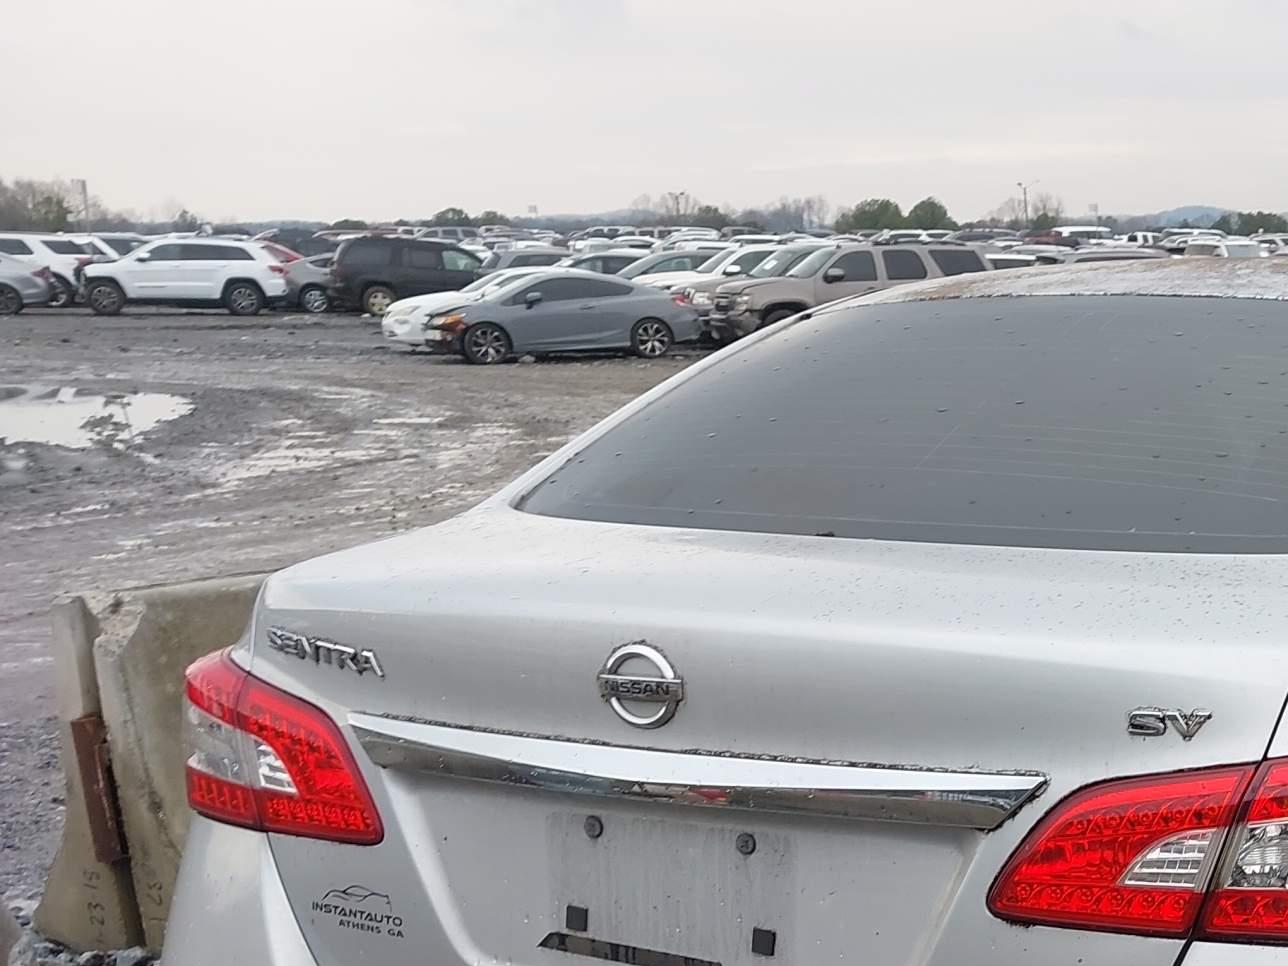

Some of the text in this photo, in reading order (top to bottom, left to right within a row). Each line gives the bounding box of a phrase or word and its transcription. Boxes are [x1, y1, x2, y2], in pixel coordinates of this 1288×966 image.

[266, 626, 385, 678] SENTRA
[604, 680, 670, 696] NISSAN
[1127, 707, 1213, 741] SV
[312, 901, 403, 927] INSTANTAUTO
[339, 919, 405, 938] ATHENS GA
